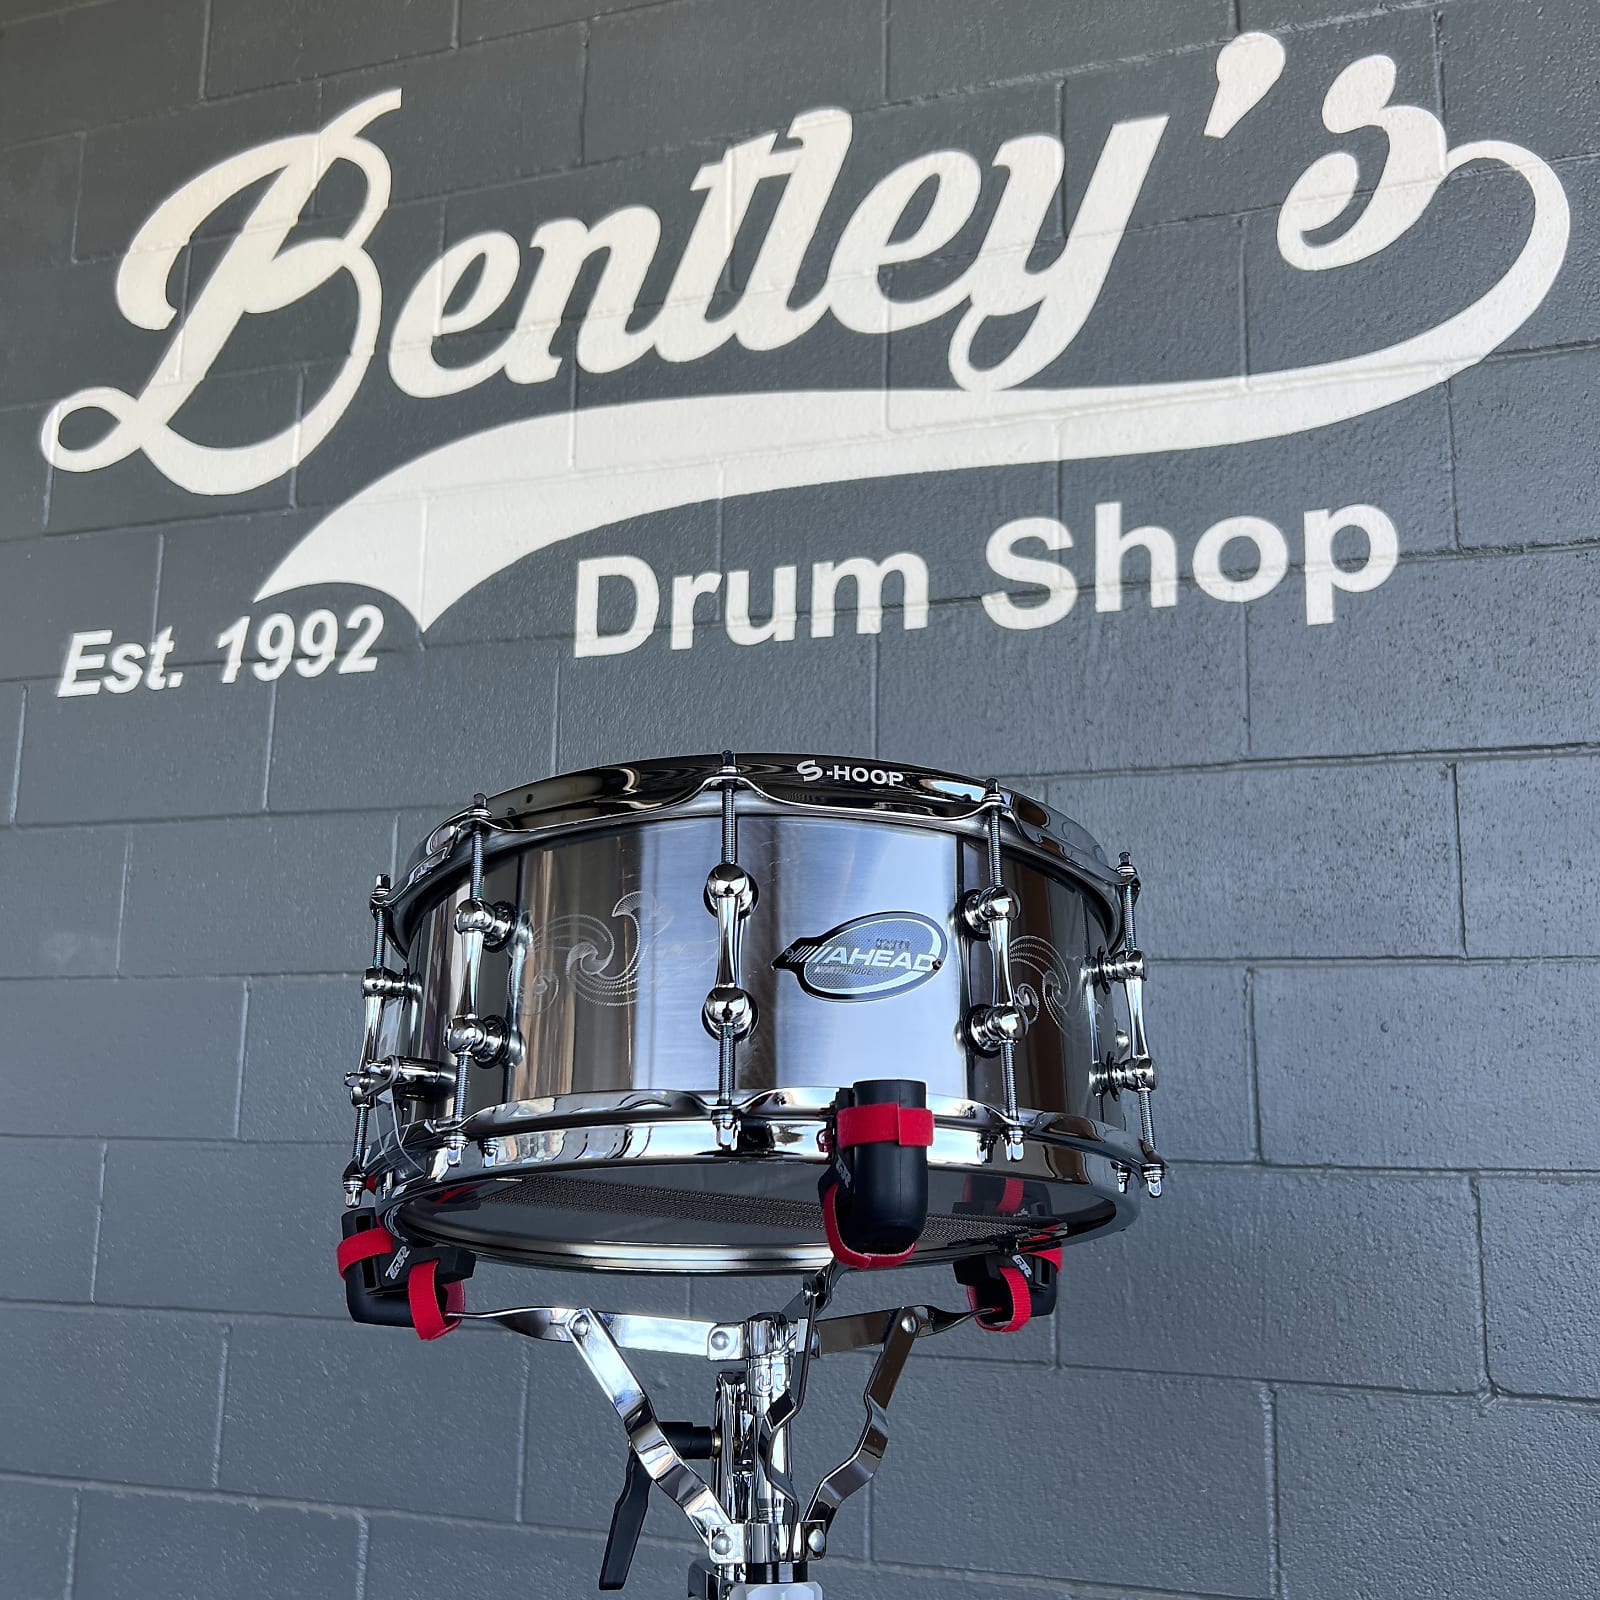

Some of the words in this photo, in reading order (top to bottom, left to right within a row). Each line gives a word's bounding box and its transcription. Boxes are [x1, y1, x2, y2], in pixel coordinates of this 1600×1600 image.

[41, 30, 1570, 496] Bentley's
[573, 553, 929, 659] Drum
[981, 501, 1400, 630] Shop
[57, 626, 184, 698] Est.
[217, 604, 384, 684] 1992
[796, 759, 904, 786] S-HOOP
[824, 946, 936, 972] AHEAD
